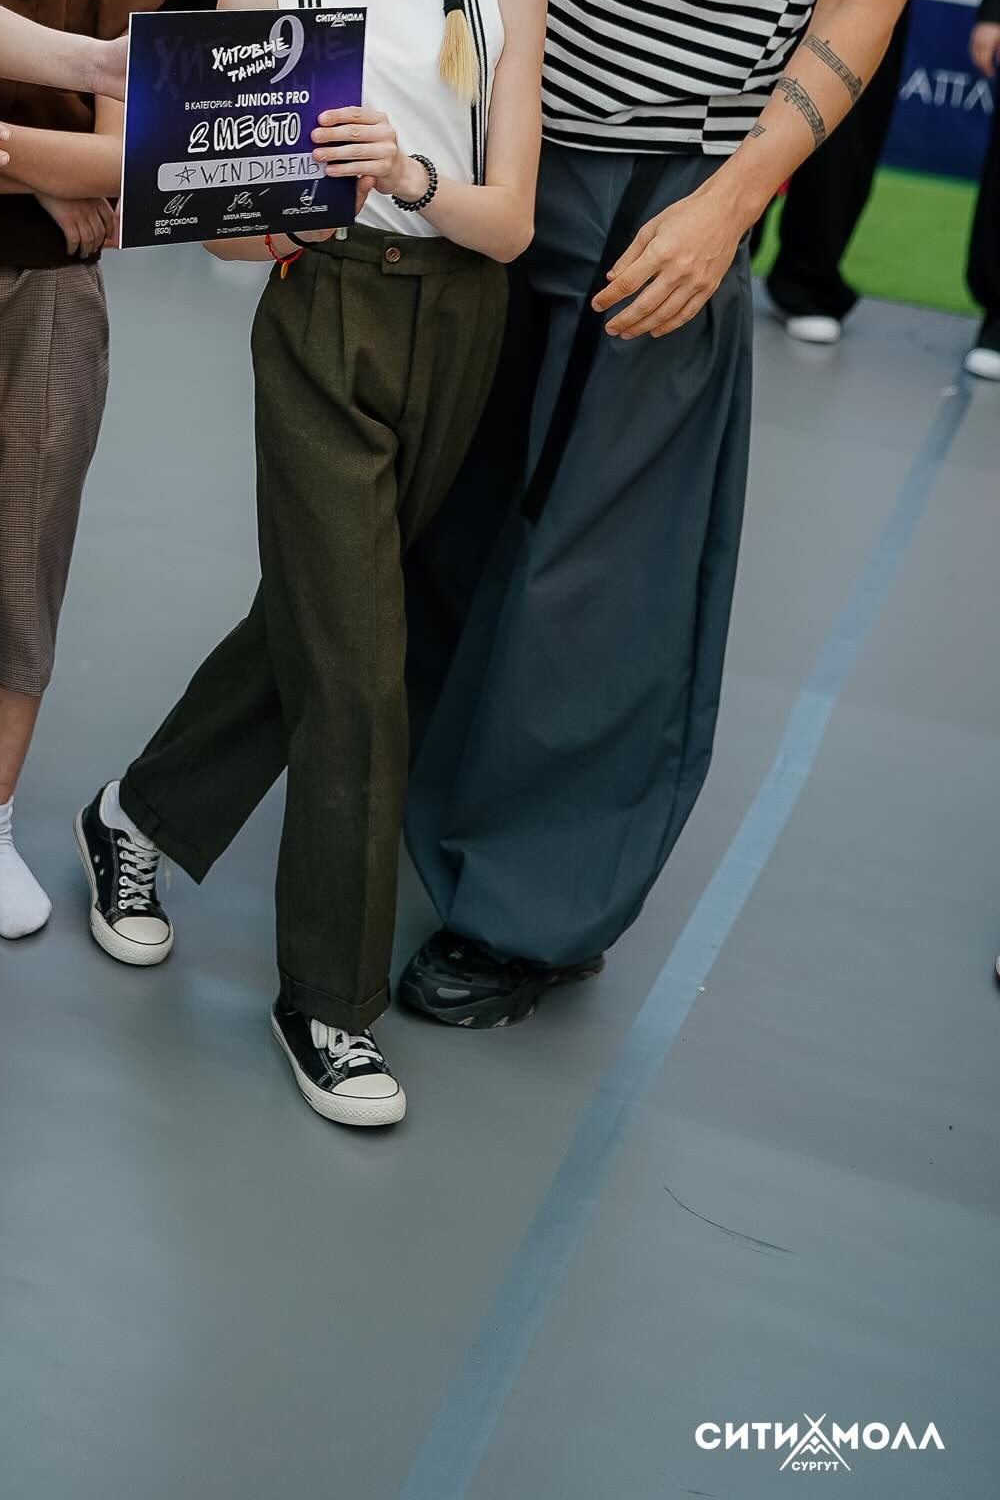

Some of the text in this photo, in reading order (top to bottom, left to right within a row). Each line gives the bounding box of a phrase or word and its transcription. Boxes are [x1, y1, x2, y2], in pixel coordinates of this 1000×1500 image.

[211, 14, 305, 84] ХИТОВЫЕ 9
[227, 56, 276, 83] ТАНЦЫ
[185, 102, 190, 111] В
[235, 92, 284, 108] JUNIORS
[285, 90, 310, 105] PRO
[187, 112, 302, 153] 2 МЕСТО
[200, 161, 242, 185] WIN
